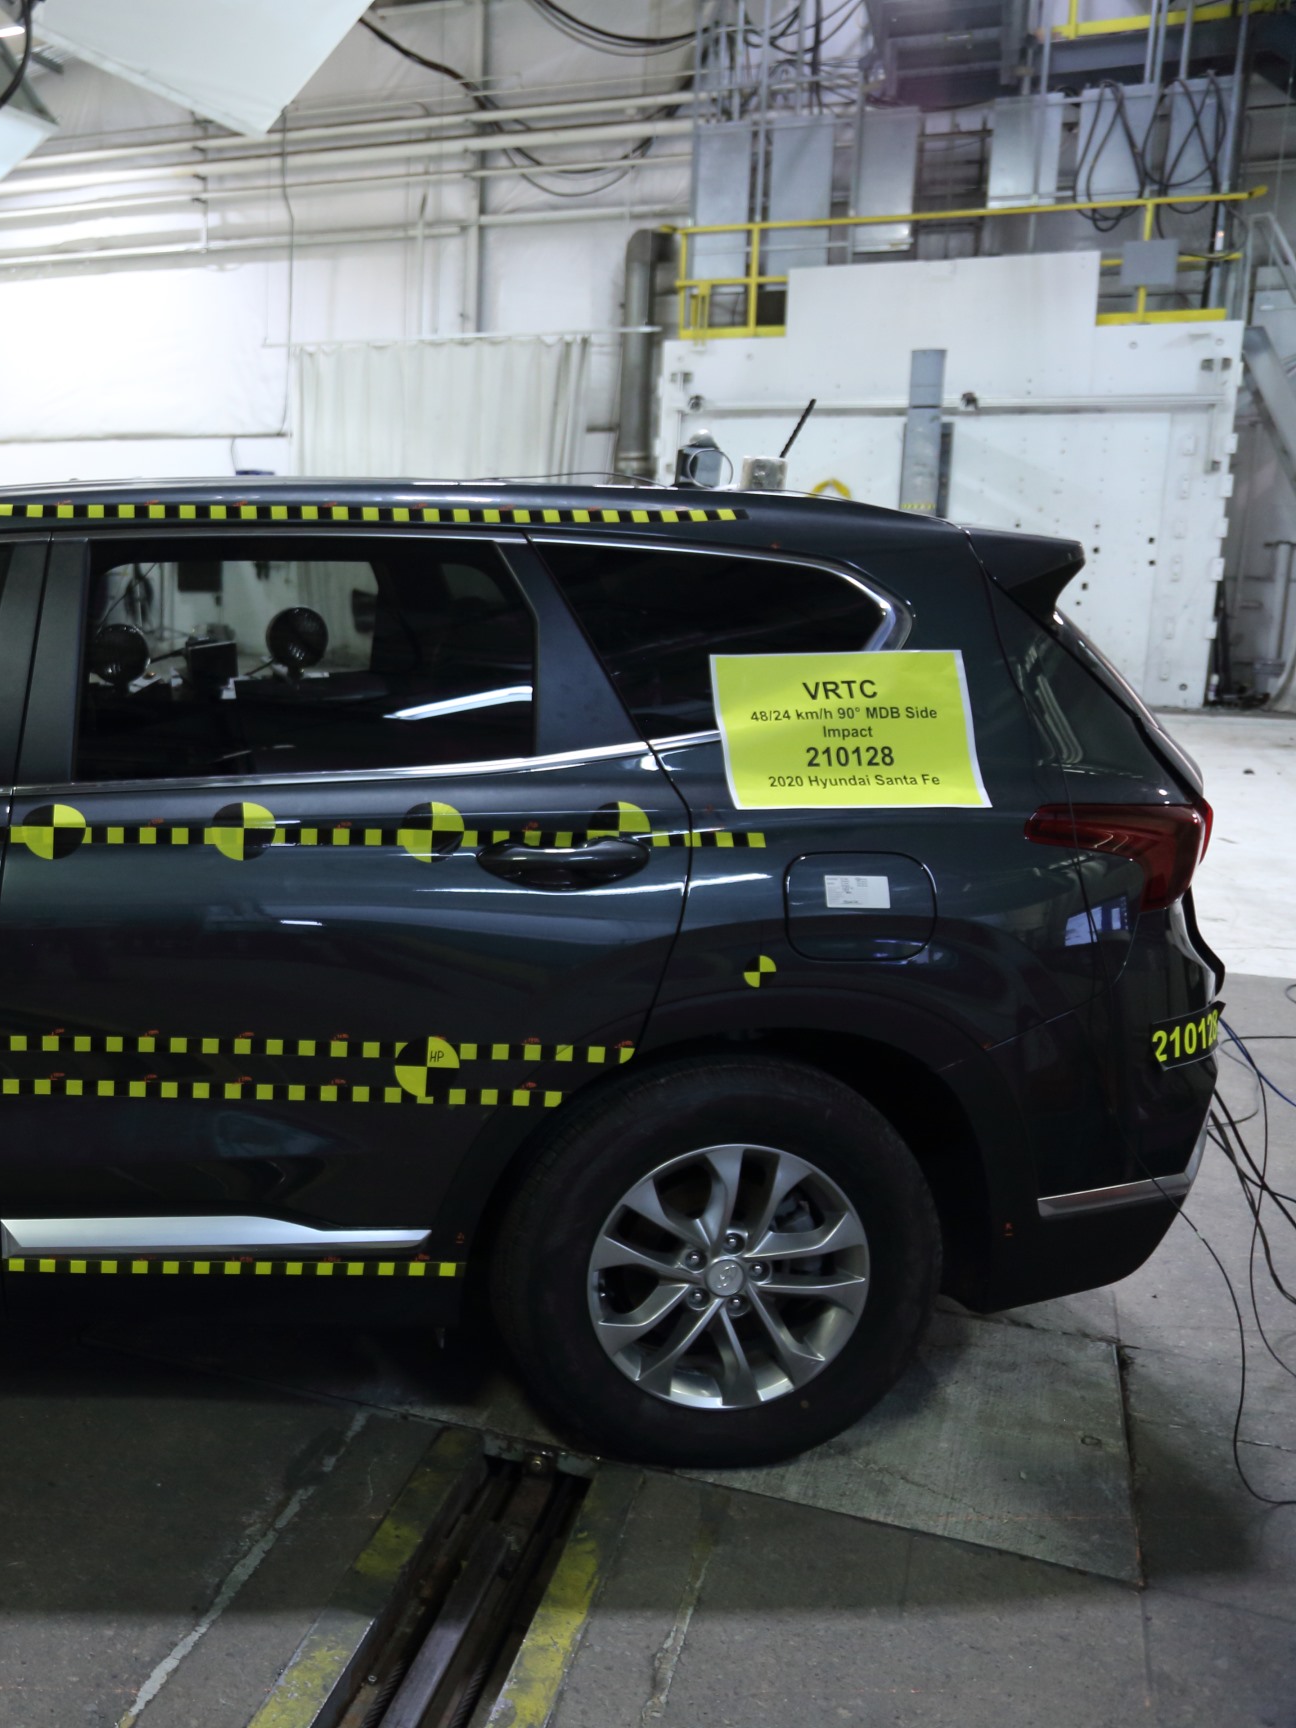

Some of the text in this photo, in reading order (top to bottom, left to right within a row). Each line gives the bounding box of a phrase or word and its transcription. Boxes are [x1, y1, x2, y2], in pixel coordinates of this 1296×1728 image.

[802, 679, 878, 701] VRTC
[750, 709, 792, 722] 48/24
[795, 707, 833, 721] km/h
[865, 706, 901, 719] MDB
[905, 706, 938, 719] Side
[823, 725, 873, 740] Impact
[805, 746, 895, 768] 210128
[768, 773, 941, 789] 2020 Hyundai Santa Fe
[1151, 1008, 1219, 1063] 210128
[429, 1050, 445, 1063] HP
